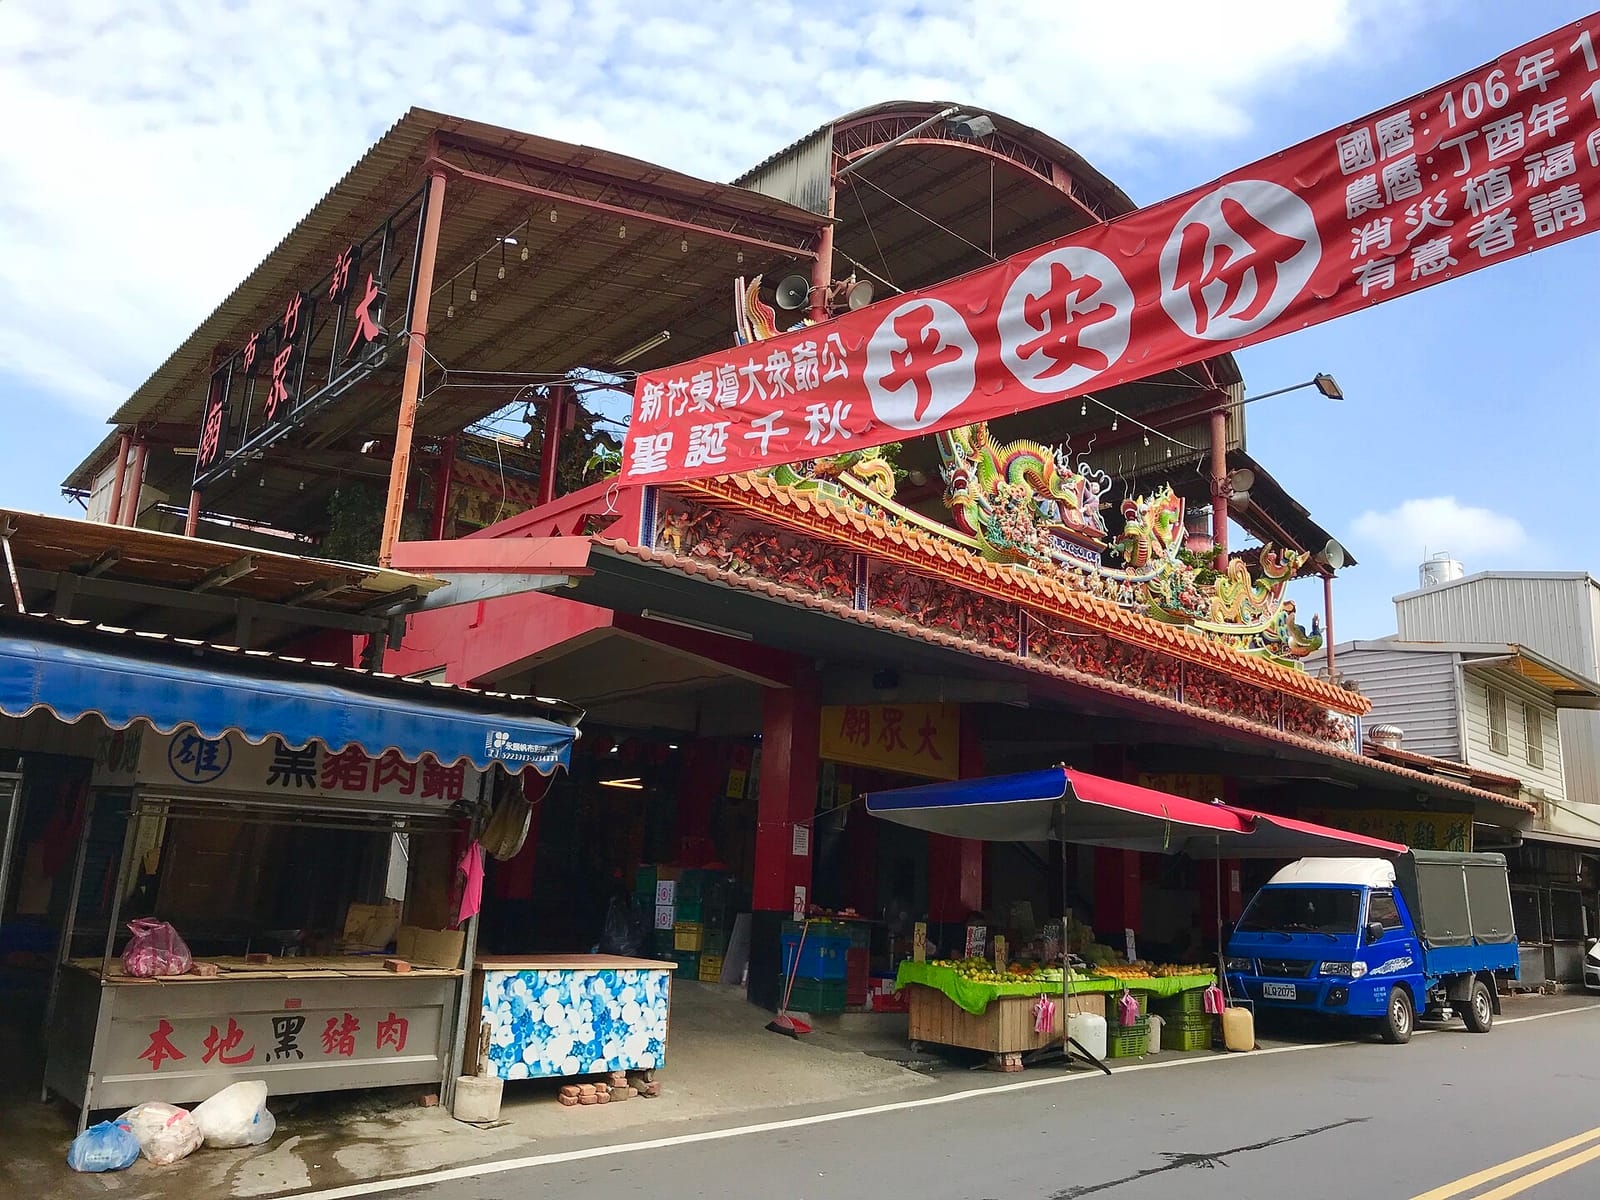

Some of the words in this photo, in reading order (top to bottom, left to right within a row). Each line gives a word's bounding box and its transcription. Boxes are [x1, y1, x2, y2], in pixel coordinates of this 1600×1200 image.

[1352, 183, 1587, 297] 有意者請
[627, 400, 853, 477] 聖誕千秋
[1264, 986, 1296, 998] ALQ-2075
[138, 1011, 409, 1070] 本地黑豬肉
